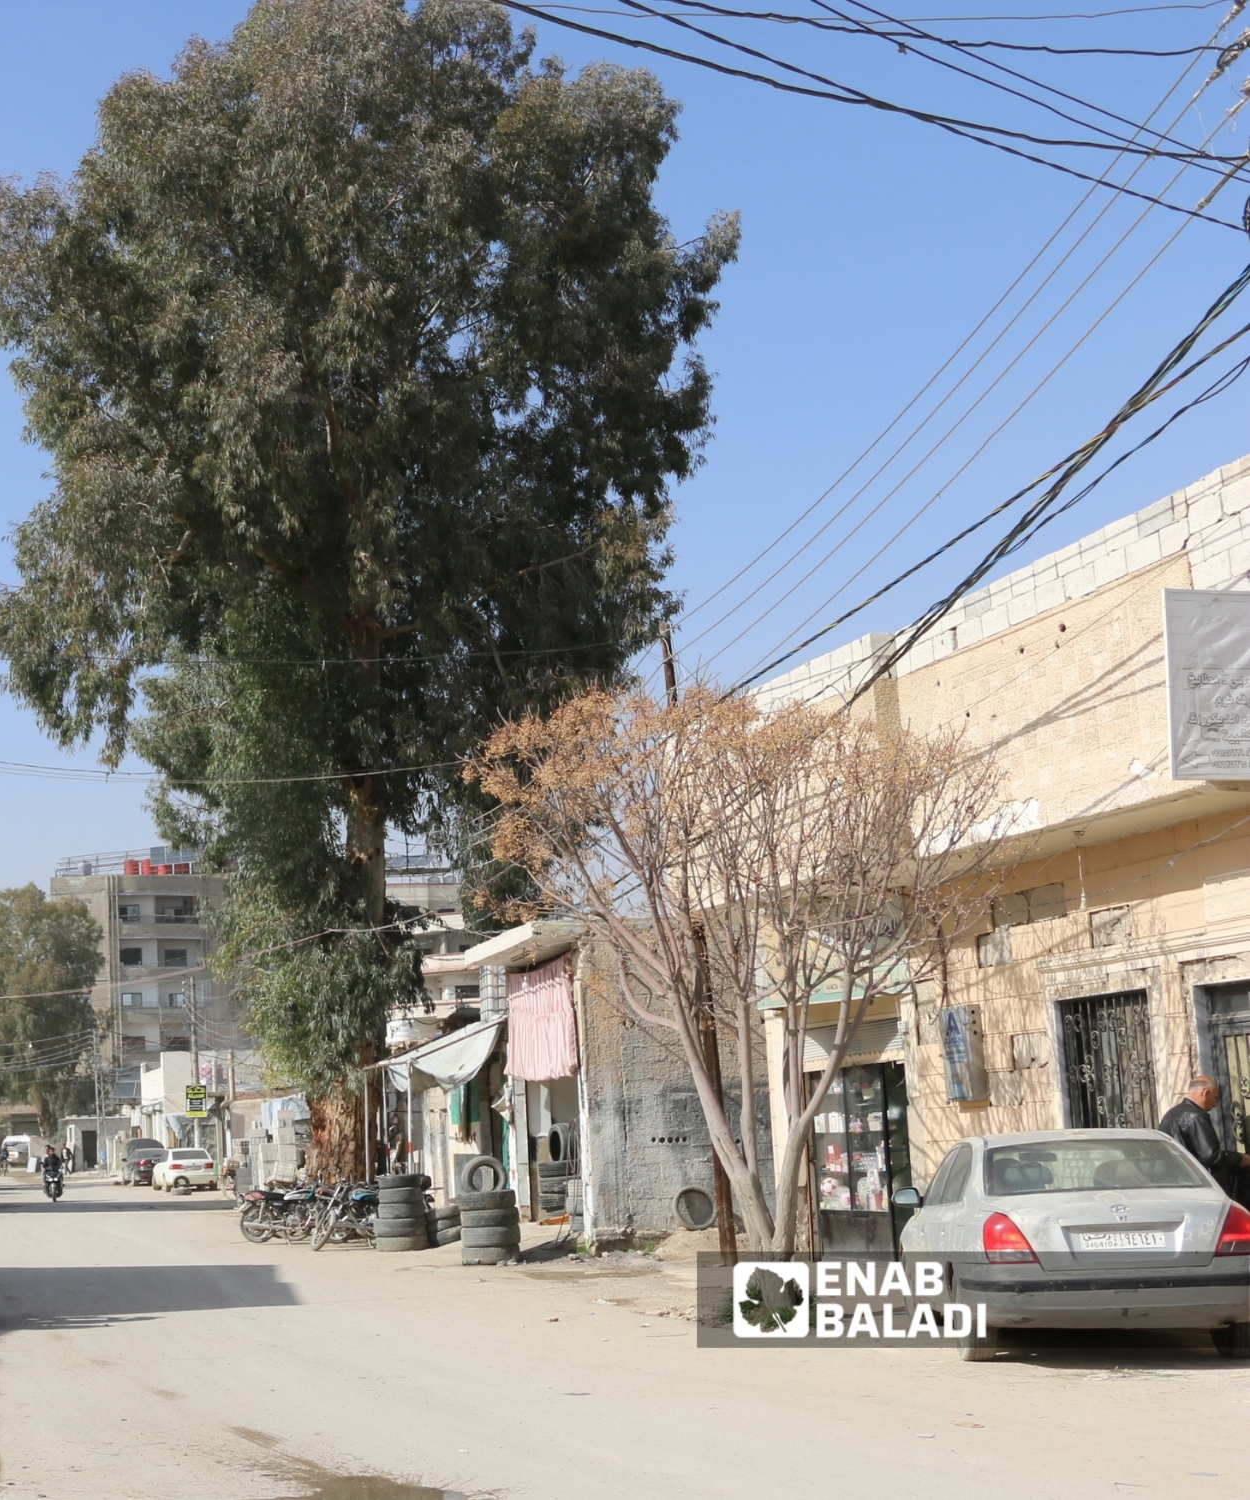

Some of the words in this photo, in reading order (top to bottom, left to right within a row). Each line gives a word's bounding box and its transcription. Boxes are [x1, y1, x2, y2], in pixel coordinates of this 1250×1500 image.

[1229, 675, 1250, 689] ربي
[1215, 692, 1234, 708] نوم
[1188, 712, 1239, 728] الديكورات
[1084, 1240, 1113, 1248] 946410
